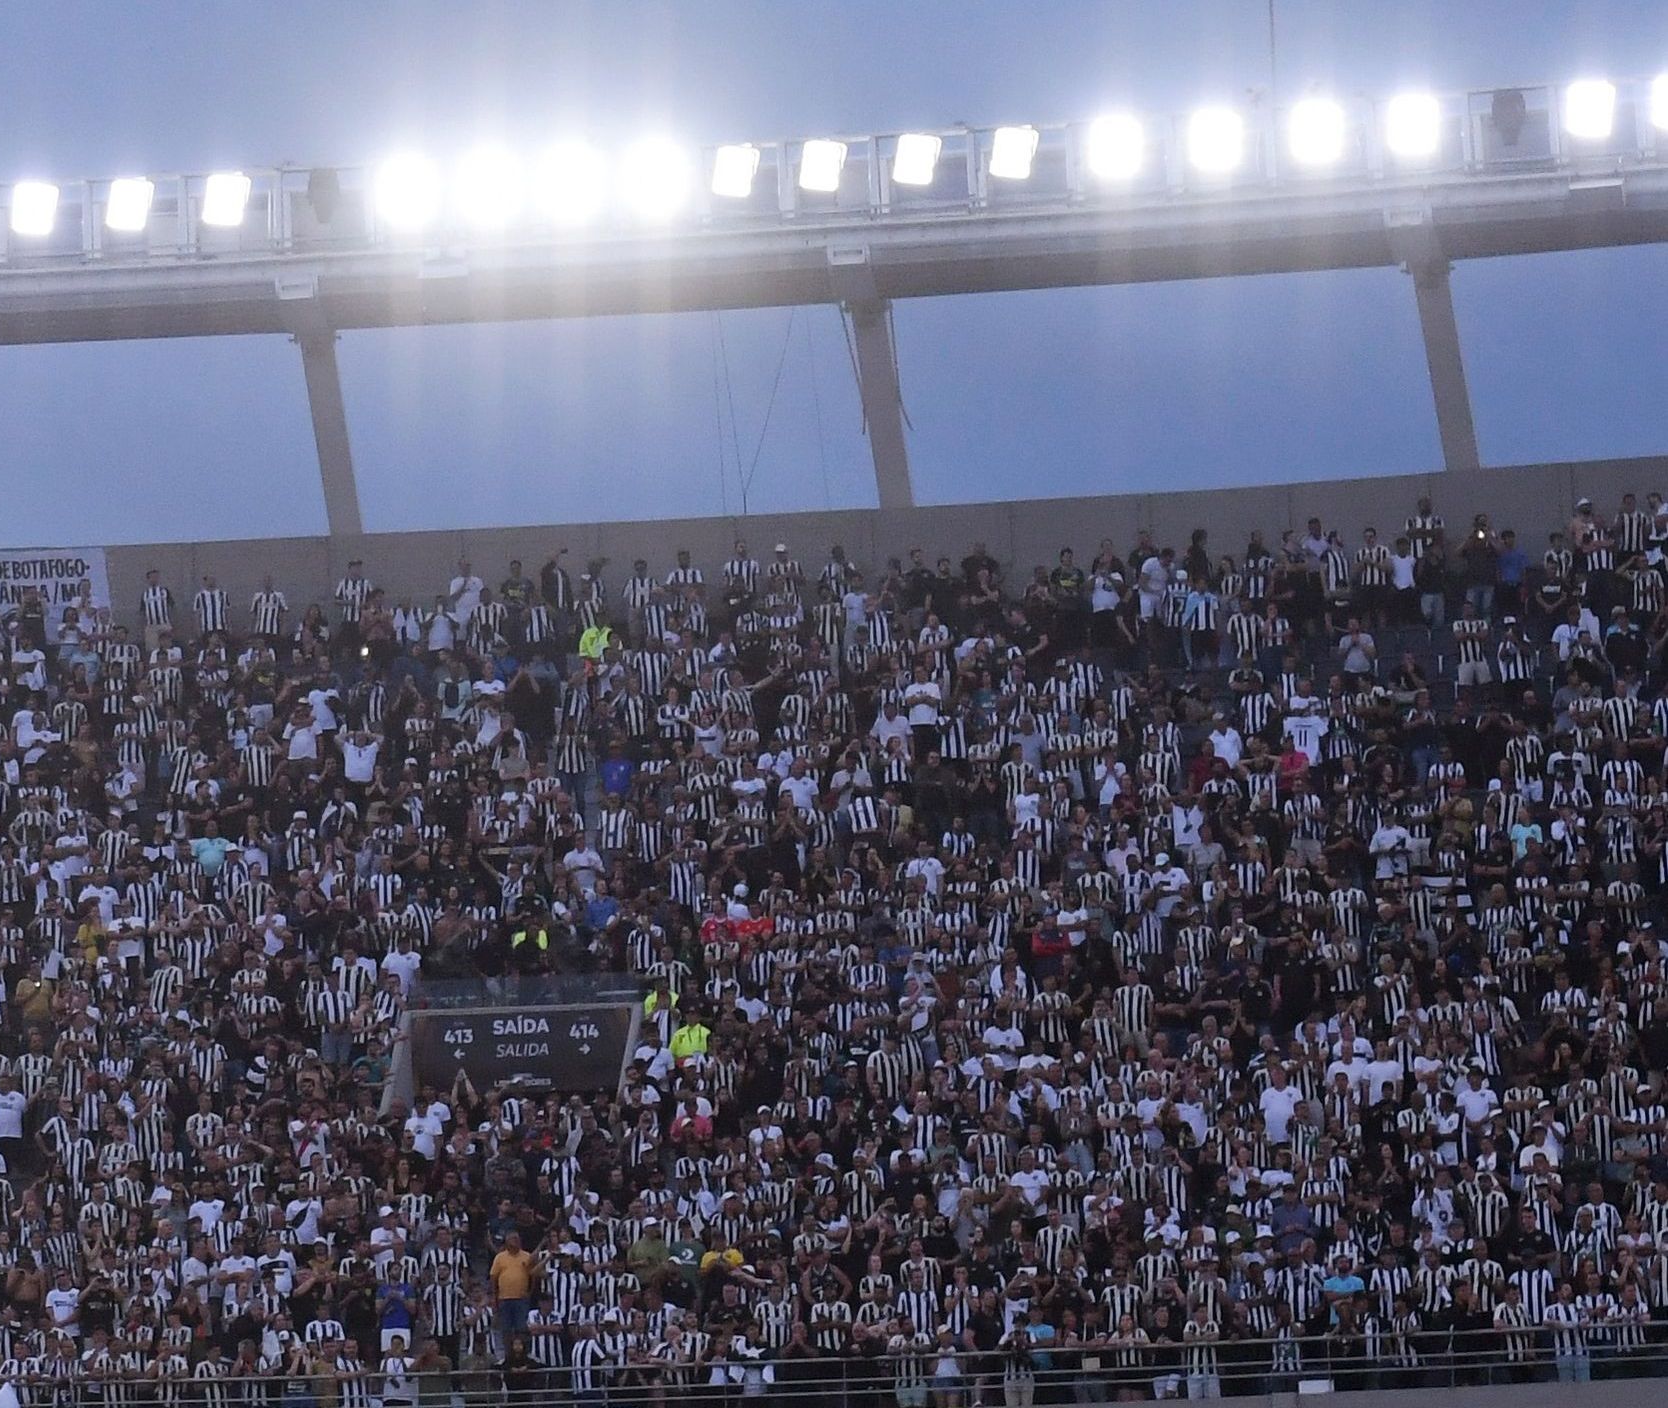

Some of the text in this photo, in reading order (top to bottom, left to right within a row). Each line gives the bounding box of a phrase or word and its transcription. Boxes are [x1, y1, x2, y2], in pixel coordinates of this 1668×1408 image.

[444, 1015, 599, 1044] 413 SAÍDA 414
[496, 1043, 549, 1058] SALIDA
